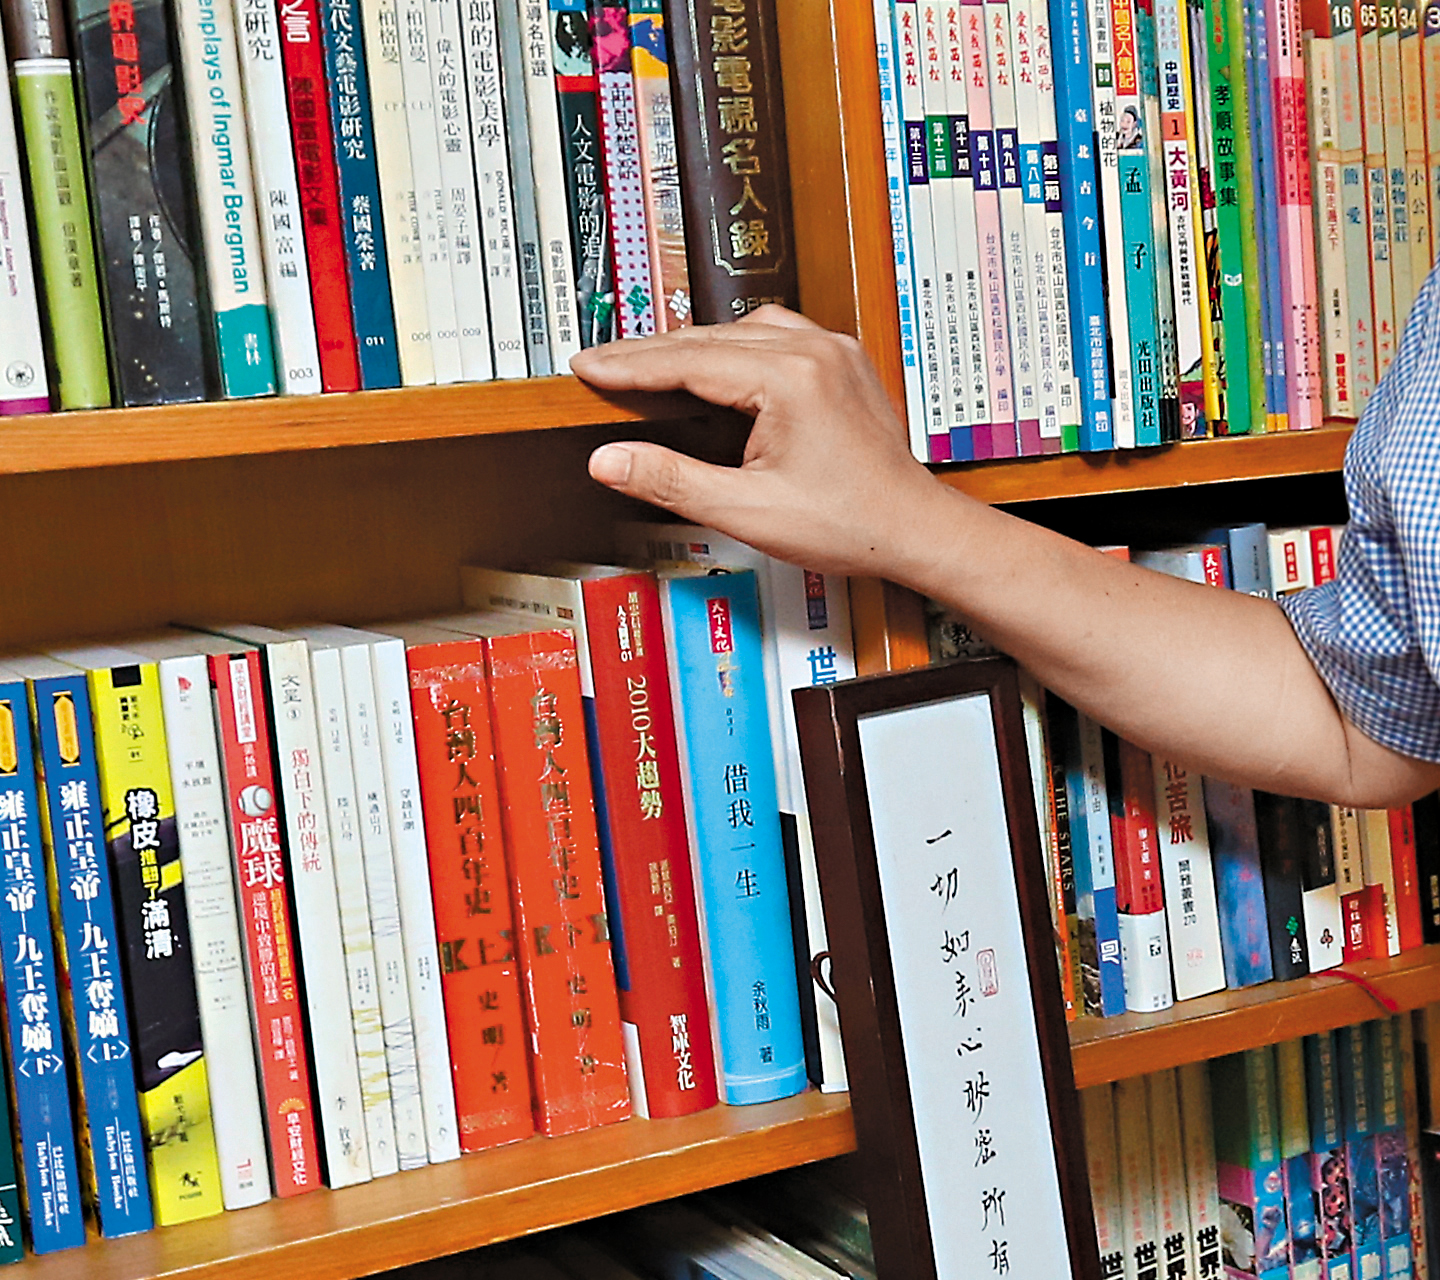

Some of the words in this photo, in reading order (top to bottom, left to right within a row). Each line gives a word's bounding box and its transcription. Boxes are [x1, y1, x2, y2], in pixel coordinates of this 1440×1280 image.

[1331, 5, 1352, 28] 16
[1360, 4, 1377, 27] 65
[1380, 5, 1398, 28] 51
[1399, 8, 1418, 29] 34
[211, 86, 231, 110] of
[1164, 60, 1181, 111] 中國歷史
[211, 114, 237, 185] Ingmar
[909, 127, 925, 179] 第十三期
[932, 122, 947, 173] 第十二期
[954, 120, 971, 172] 第十一期
[1001, 133, 1017, 184] 第九期
[1099, 100, 1118, 168] 植物的花
[1213, 83, 1239, 208] 孝順故事集
[976, 135, 992, 187] 第十期
[1167, 146, 1190, 212] 大黃河
[222, 195, 250, 294] Bergman
[1124, 166, 1149, 273] 孟子
[365, 336, 386, 347] 011
[288, 367, 315, 380] 003
[1136, 340, 1156, 429] 光田出版社
[240, 817, 285, 889] 魔球
[723, 763, 761, 900] 借我一生
[1058, 830, 1075, 893] STARS
